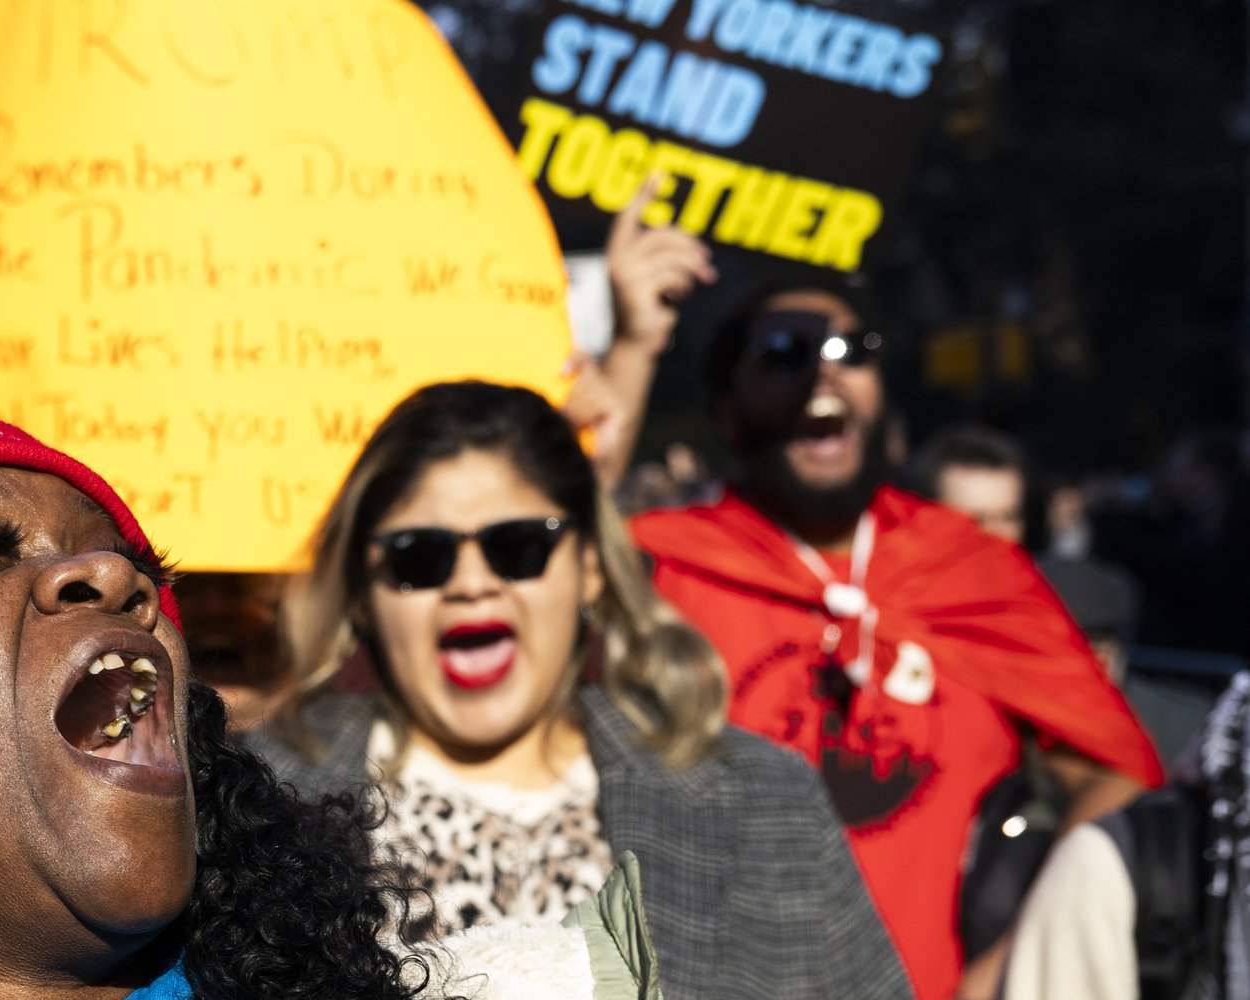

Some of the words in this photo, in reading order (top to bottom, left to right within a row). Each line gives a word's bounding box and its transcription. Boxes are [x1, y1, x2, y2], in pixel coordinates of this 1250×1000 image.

[531, 12, 767, 148] STAND
[684, 0, 942, 98] YORKERS
[516, 96, 882, 273] TOGETHER
